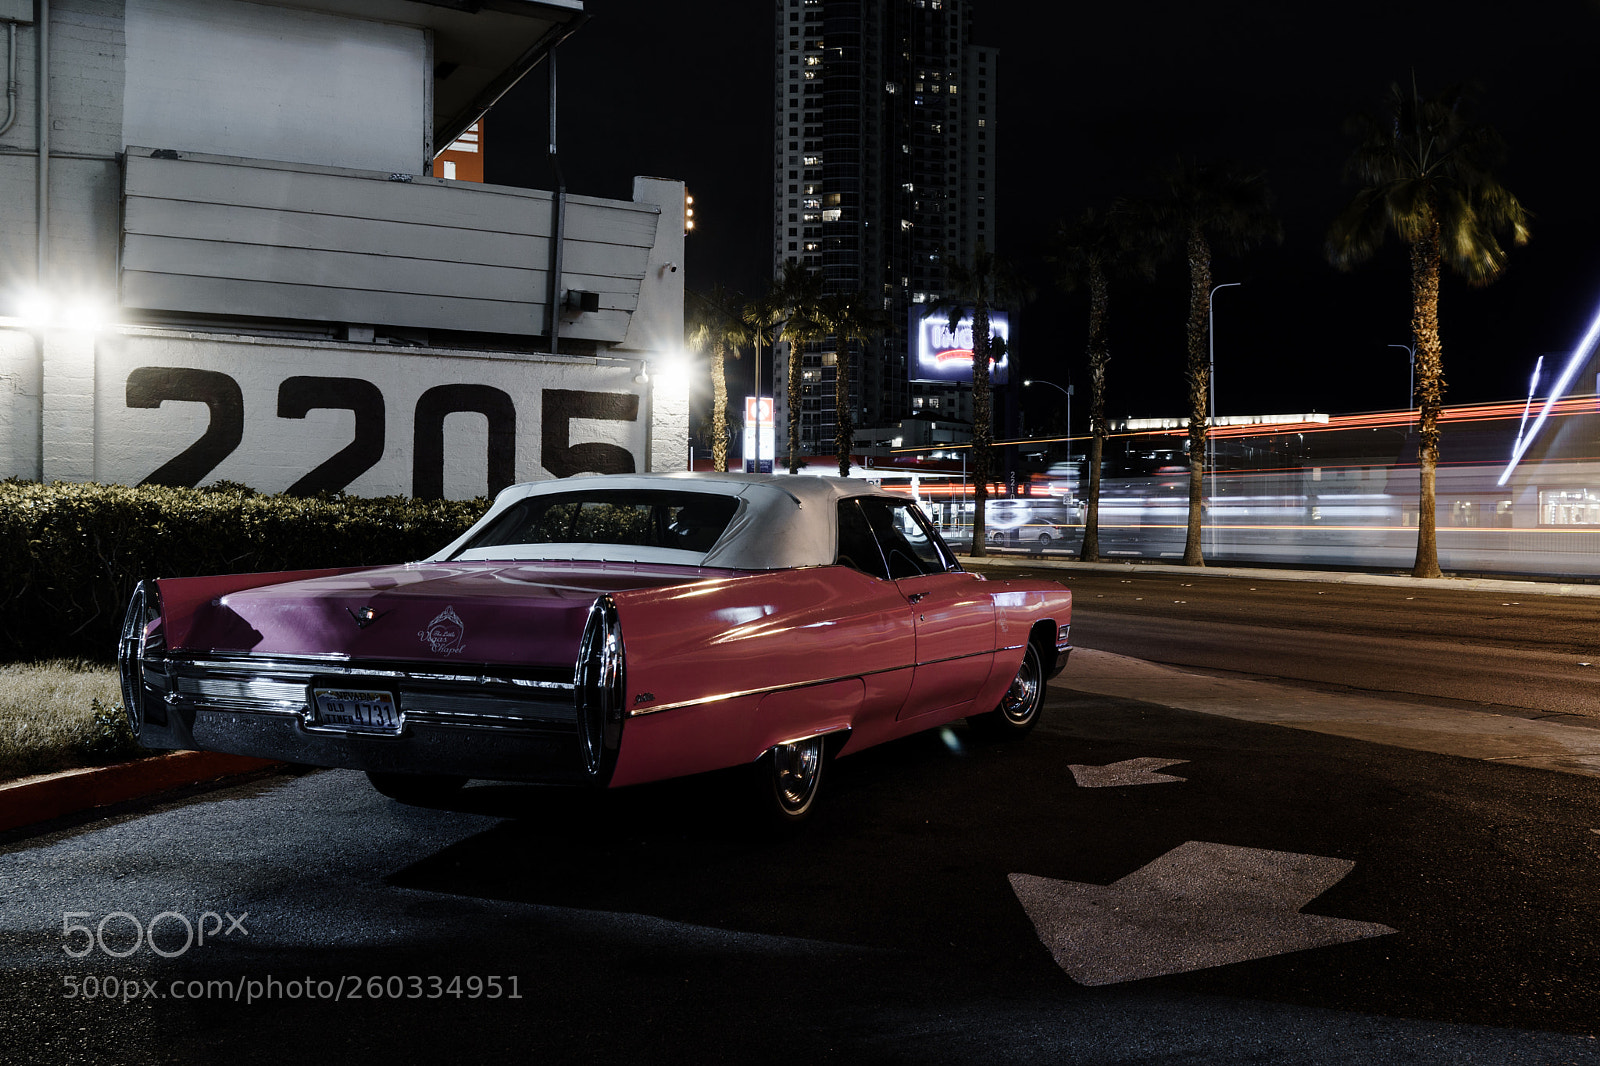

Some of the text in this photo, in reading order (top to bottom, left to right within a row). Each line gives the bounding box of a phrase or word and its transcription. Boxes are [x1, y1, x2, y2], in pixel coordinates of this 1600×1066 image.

[125, 366, 640, 500] 2205
[417, 630, 447, 642] Vegas
[430, 643, 466, 657] Chapel
[337, 691, 373, 701] NEVADA
[326, 702, 345, 712] OLD
[355, 703, 396, 727] 4731
